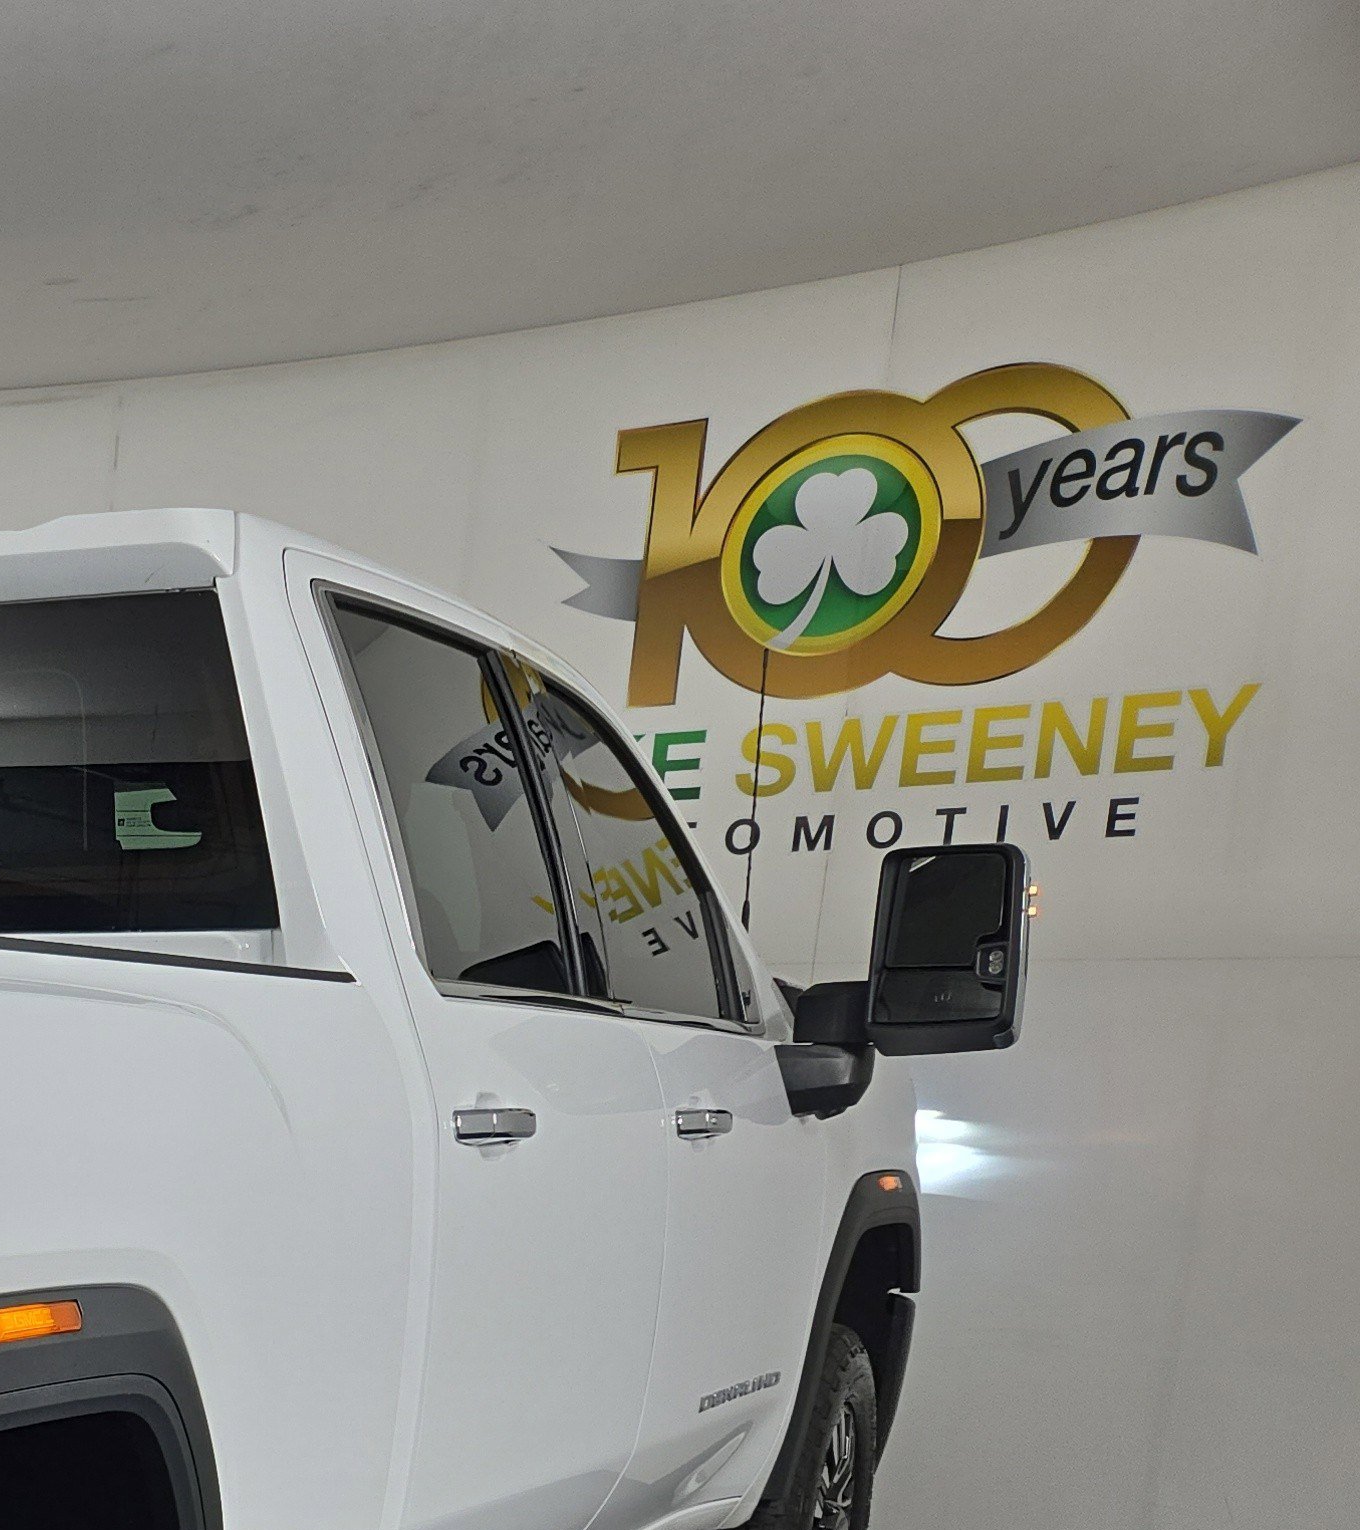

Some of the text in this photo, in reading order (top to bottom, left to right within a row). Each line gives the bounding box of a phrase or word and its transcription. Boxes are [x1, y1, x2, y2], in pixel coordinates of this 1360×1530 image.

[998, 428, 1227, 540] years
[735, 682, 1262, 799] SWEENEY
[687, 796, 1142, 856] OMOTIVE
